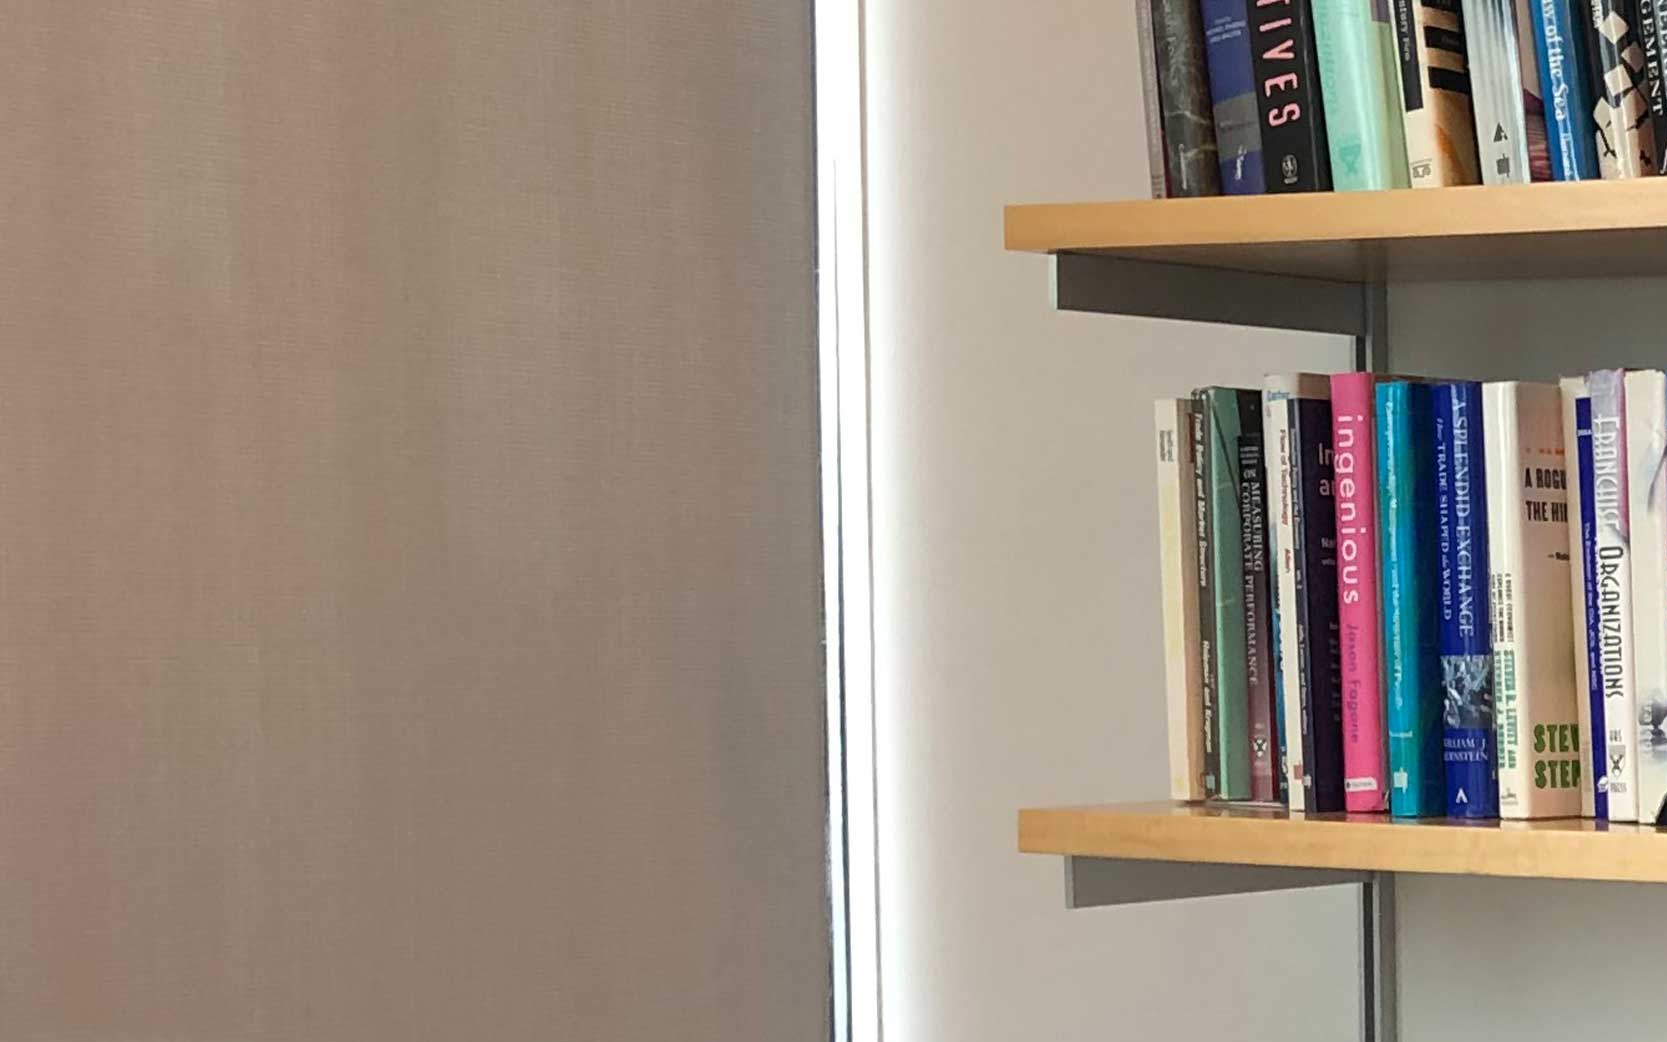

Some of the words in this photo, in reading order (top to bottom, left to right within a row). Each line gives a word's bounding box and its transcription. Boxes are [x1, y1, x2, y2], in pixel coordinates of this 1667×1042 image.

[1549, 48, 1564, 76] the
[1552, 82, 1568, 121] Sea
[1279, 429, 1288, 452] Flow
[1280, 456, 1288, 466] of
[1197, 478, 1205, 496] and
[1438, 443, 1447, 491] TRADE
[1453, 416, 1471, 517] SPLENDID
[1524, 467, 1533, 489] A
[1594, 416, 1620, 530] FRANCHISE
[1197, 501, 1207, 538] Market
[1279, 468, 1290, 525] Technology
[1334, 415, 1366, 604] ingenious
[1525, 500, 1548, 522] THE
[1241, 482, 1252, 571] CORPORATE
[1440, 496, 1449, 550] SHAPED
[1199, 541, 1208, 587] Structure
[1456, 524, 1474, 636] EXCHANGE
[1442, 569, 1452, 620] WORLD
[1244, 576, 1258, 685] PERFORMANCE
[1600, 546, 1625, 698] ORGANIZATIONS
